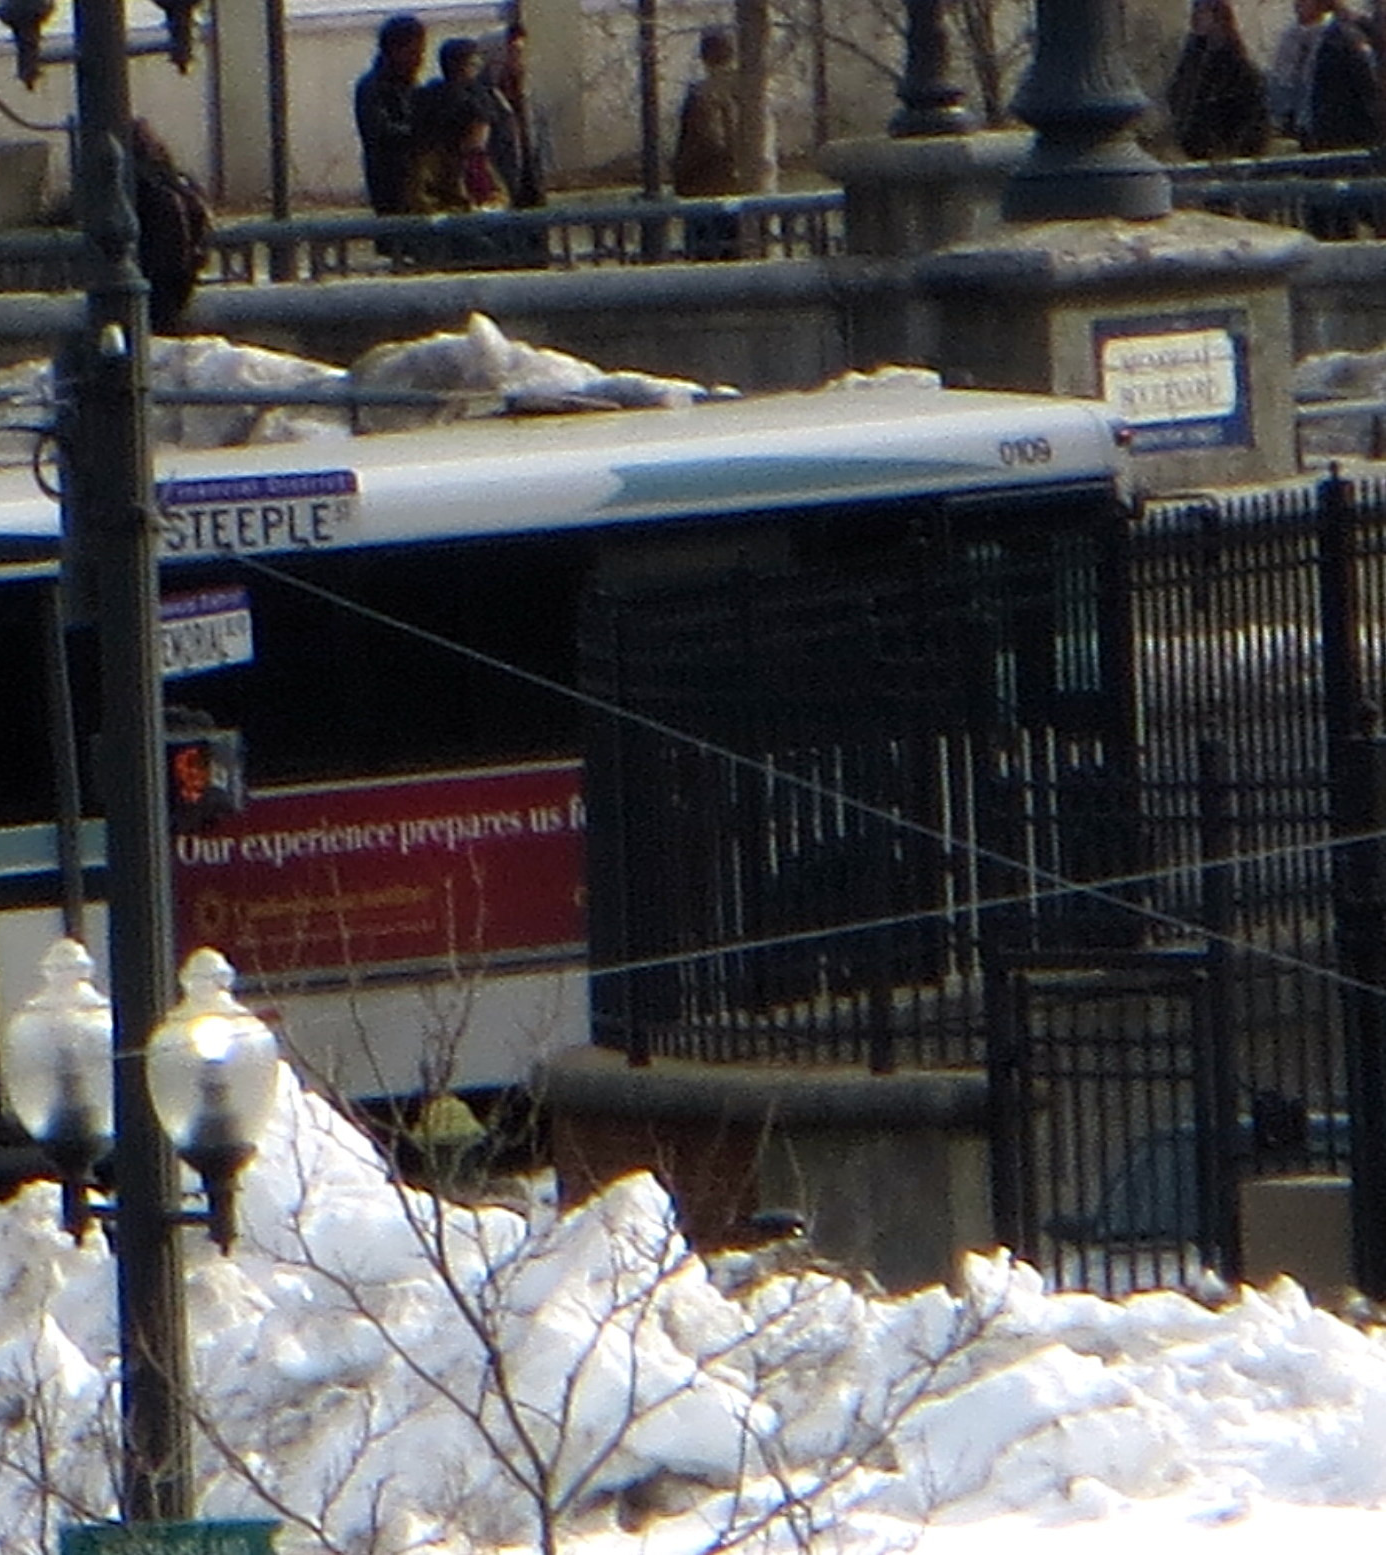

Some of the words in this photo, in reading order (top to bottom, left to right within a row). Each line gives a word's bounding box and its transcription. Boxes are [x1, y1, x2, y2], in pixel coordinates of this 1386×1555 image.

[999, 437, 1051, 465] 0109
[162, 502, 333, 550] STEEPLE
[177, 834, 236, 866] Our
[240, 816, 395, 868] experience
[399, 811, 523, 855] prepares
[529, 806, 564, 833] us
